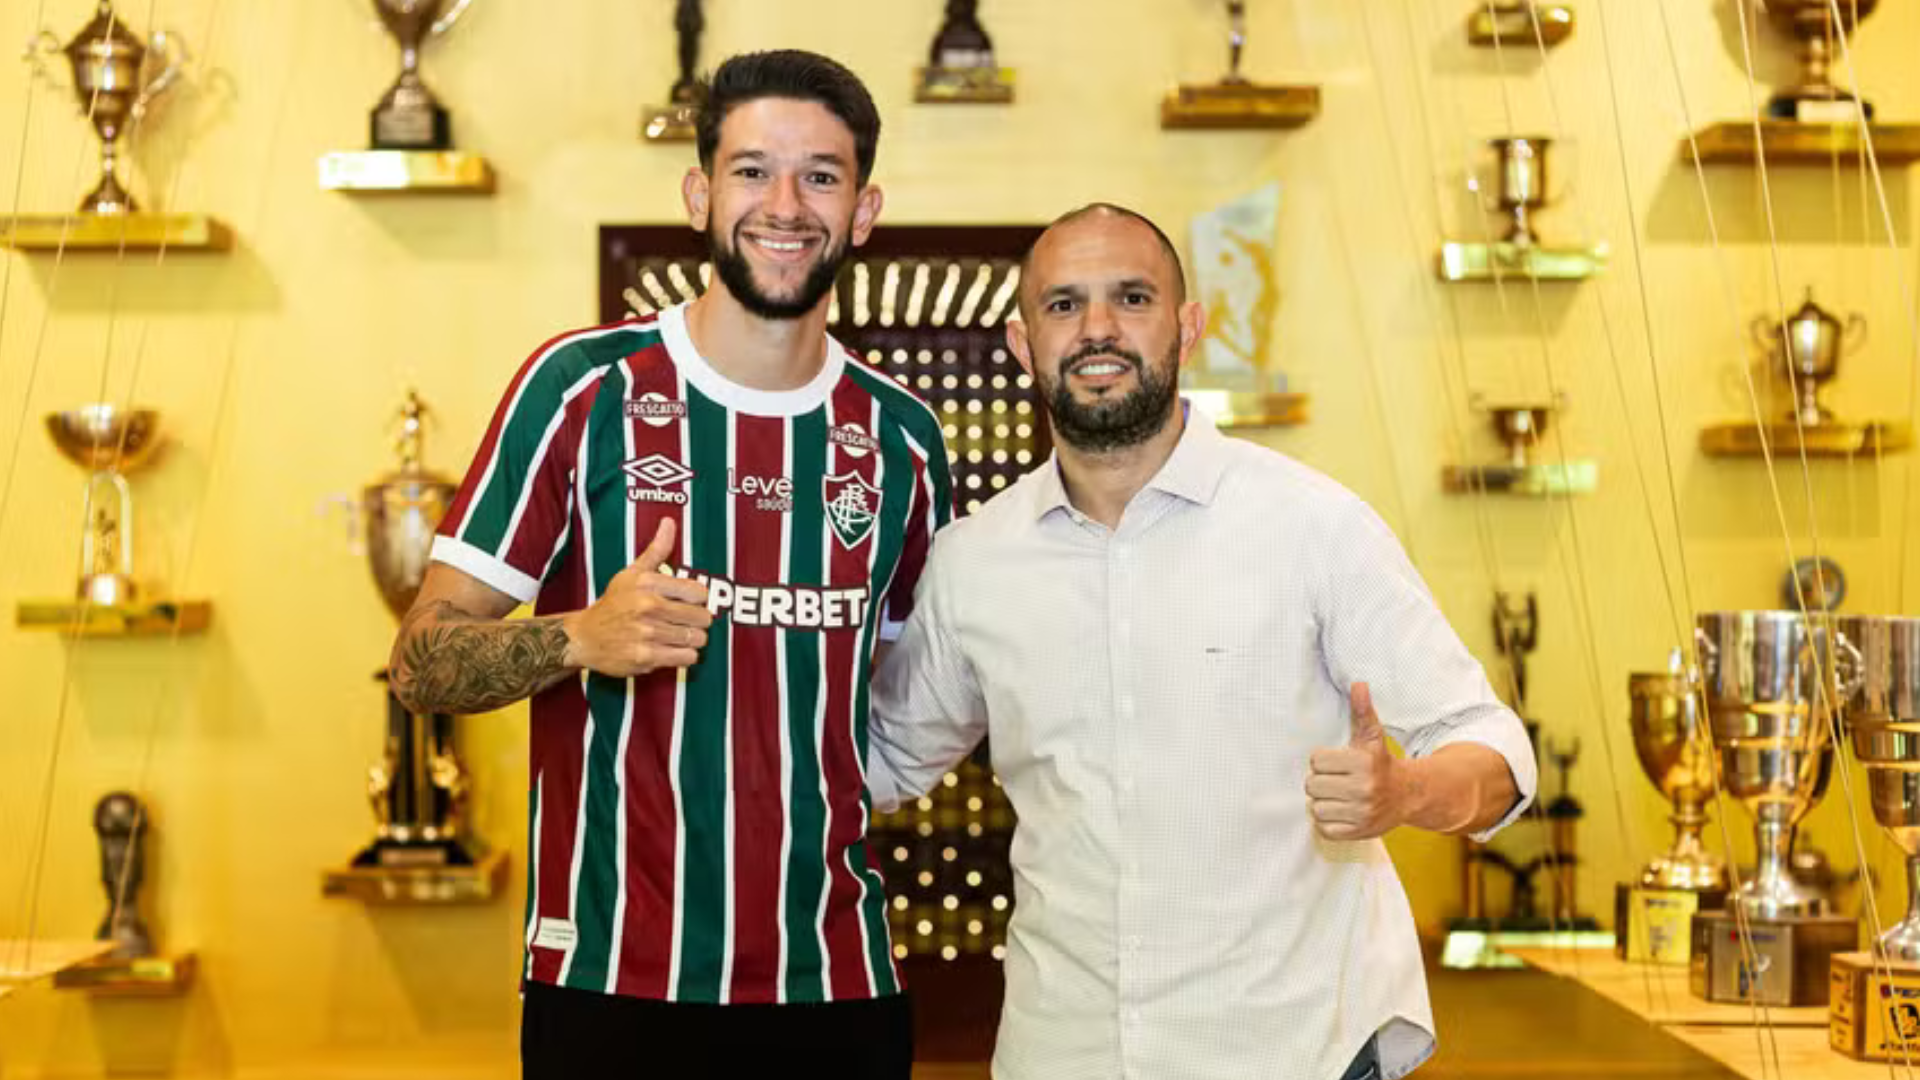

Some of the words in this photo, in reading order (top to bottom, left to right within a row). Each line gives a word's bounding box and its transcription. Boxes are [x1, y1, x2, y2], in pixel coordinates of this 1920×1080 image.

[626, 403, 684, 416] FRESCATTO
[727, 468, 793, 497] Leve
[628, 488, 686, 504] umbro
[658, 563, 867, 626] PERBET
